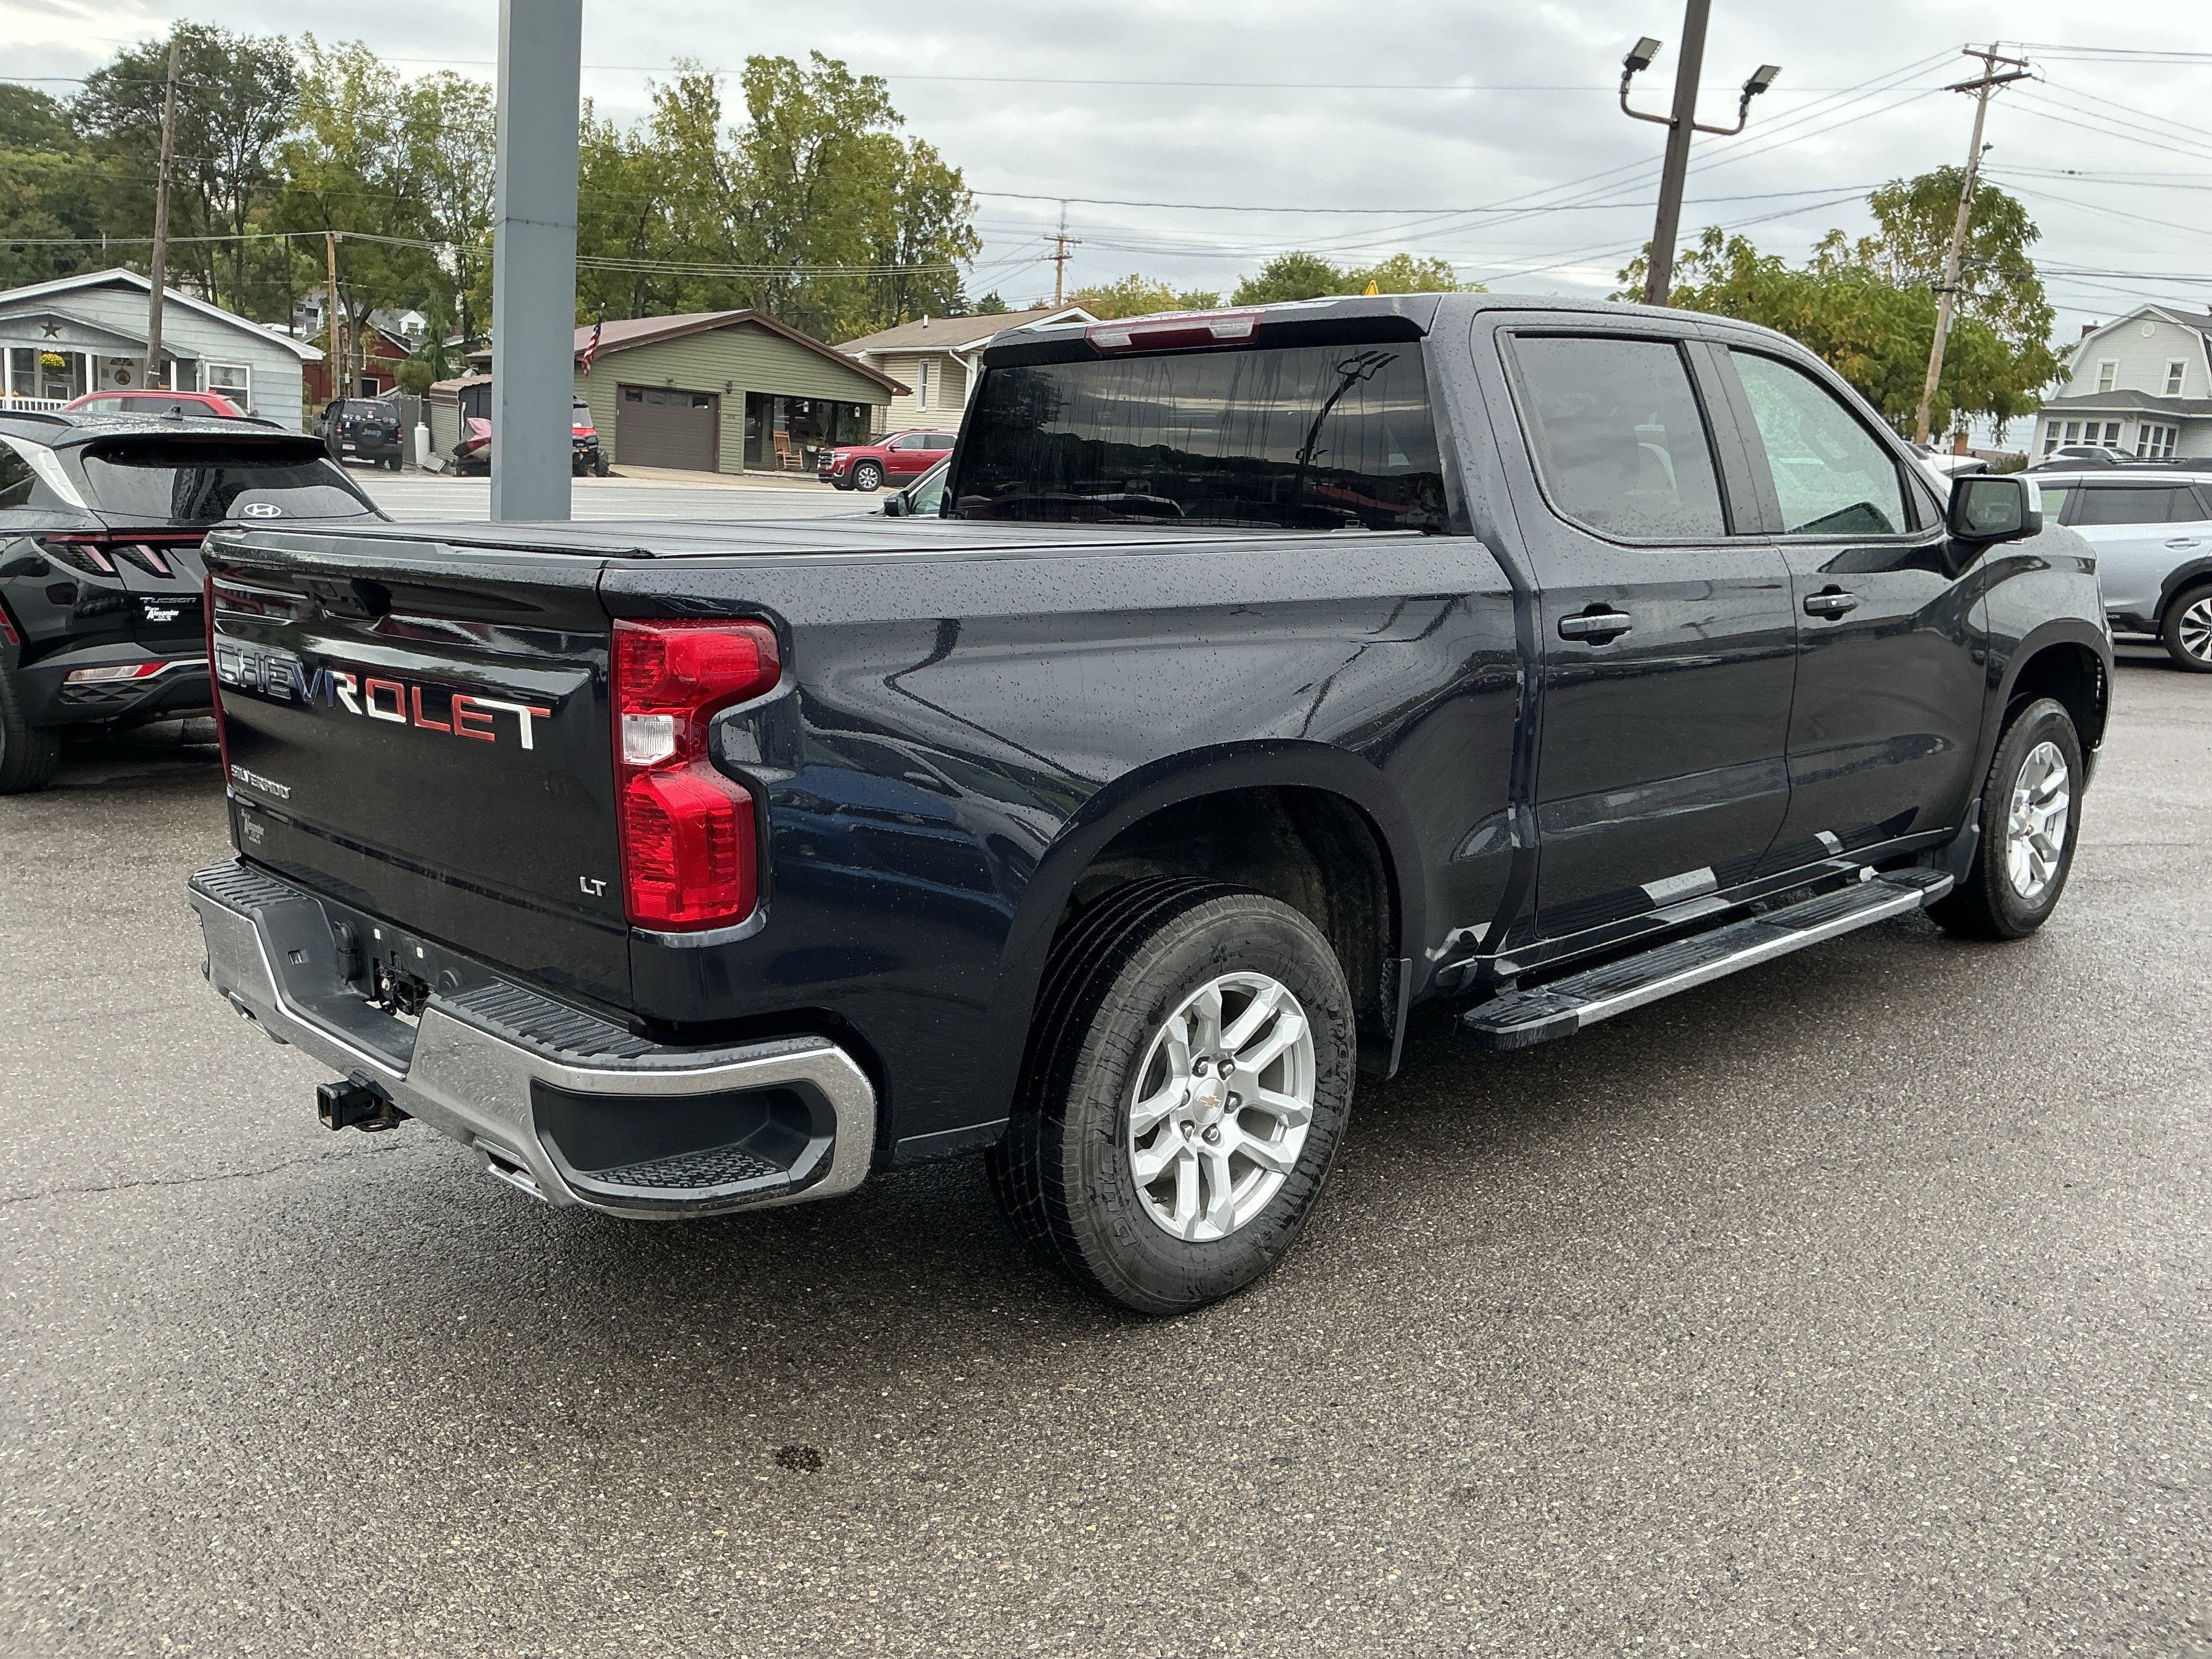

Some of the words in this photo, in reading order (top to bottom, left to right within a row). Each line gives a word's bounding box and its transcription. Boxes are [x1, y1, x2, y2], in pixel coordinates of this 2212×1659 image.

[362, 428, 382, 438] Jeep
[216, 642, 551, 751] CHEVROLET
[579, 876, 607, 897] LT
